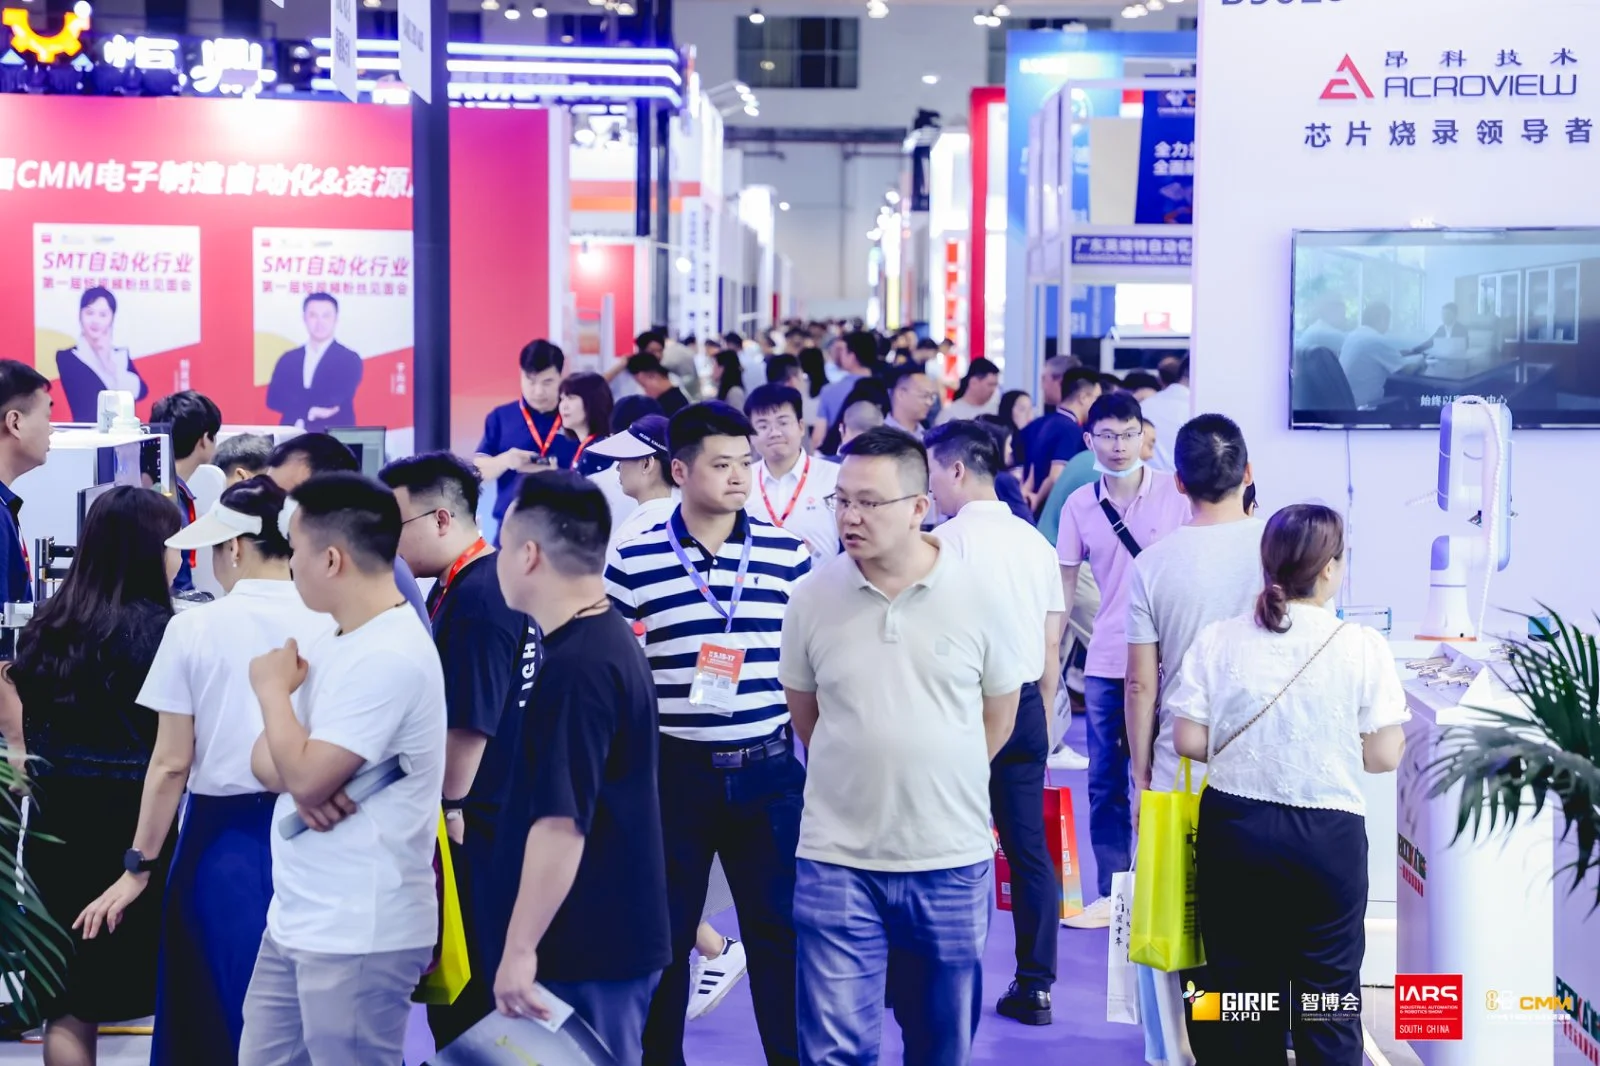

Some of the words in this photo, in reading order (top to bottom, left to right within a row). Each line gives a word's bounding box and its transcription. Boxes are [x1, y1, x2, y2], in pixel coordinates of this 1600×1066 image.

[1384, 47, 1578, 68] 昂科技术
[1384, 74, 1578, 98] ACROVIEW
[1304, 117, 1593, 148] 芯片烧录领导者
[0, 157, 413, 198] CMM电子制造自动化&资源
[43, 251, 193, 273] SMT自动化行业
[262, 255, 410, 277] SMT自动化行业
